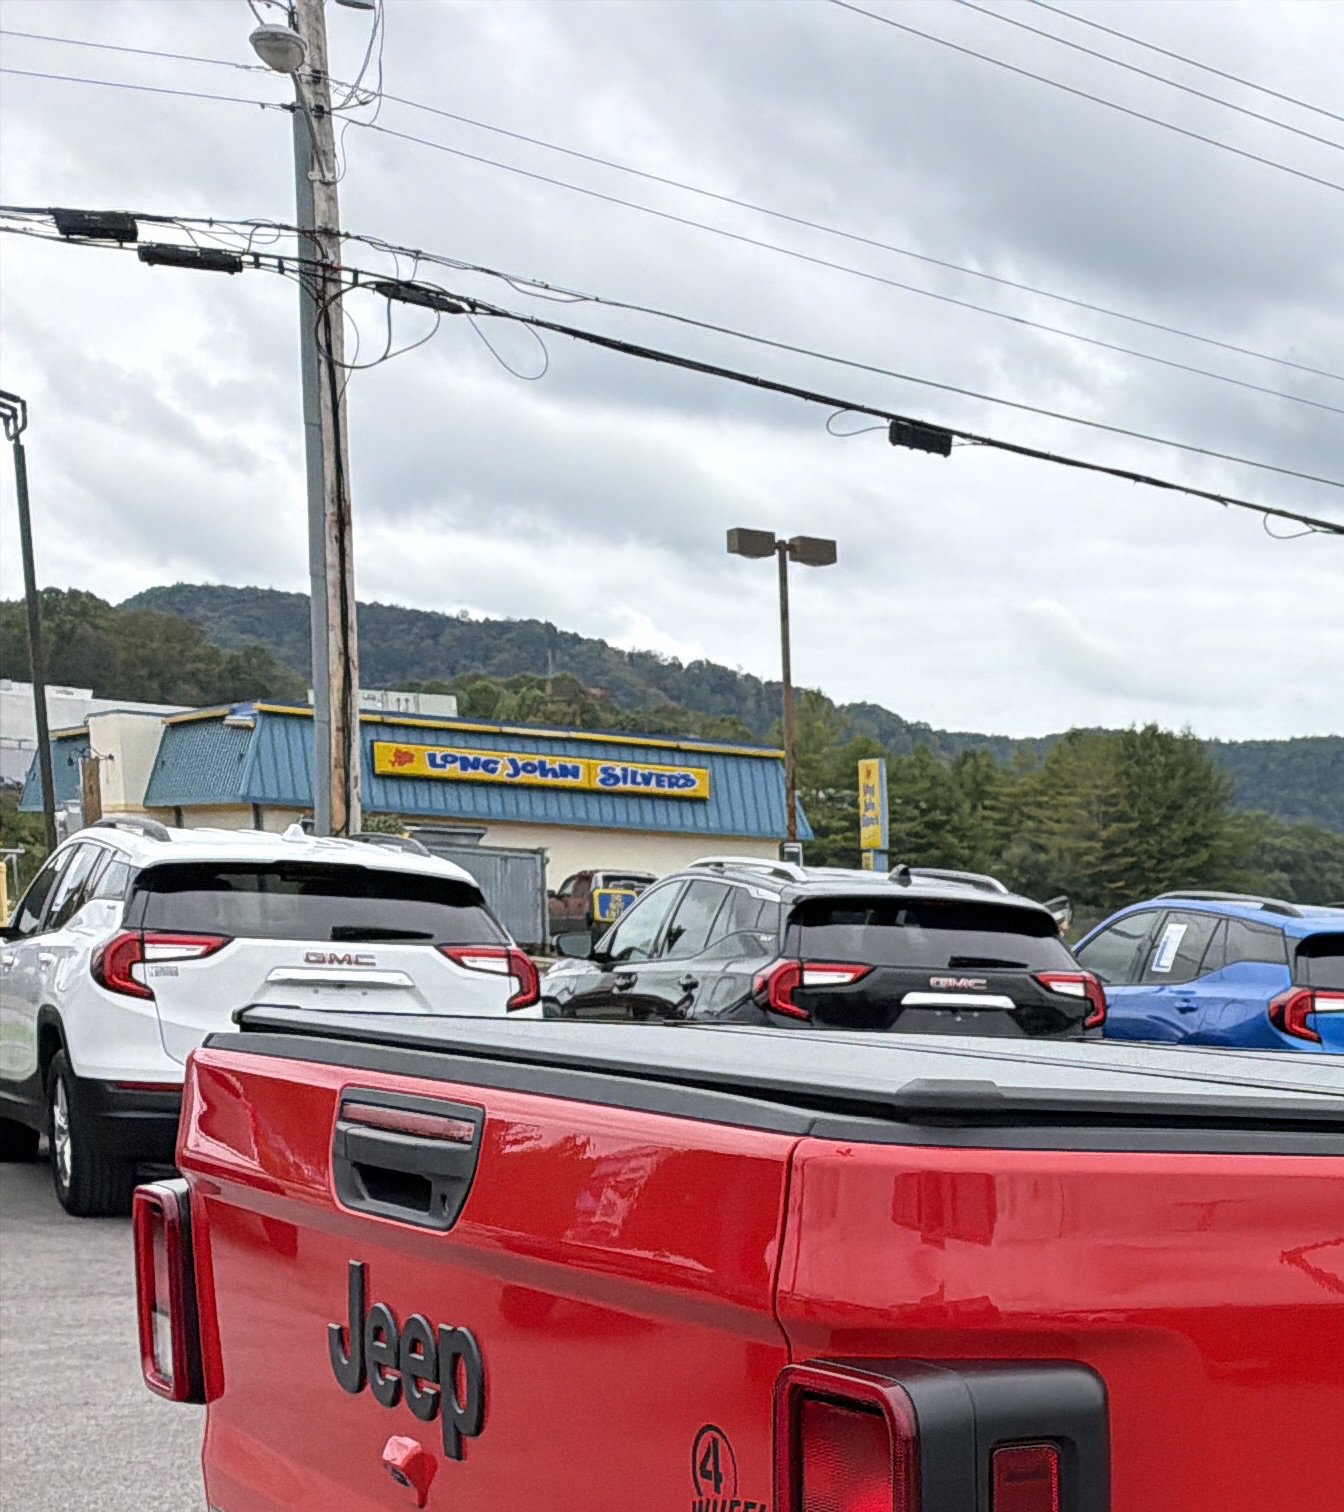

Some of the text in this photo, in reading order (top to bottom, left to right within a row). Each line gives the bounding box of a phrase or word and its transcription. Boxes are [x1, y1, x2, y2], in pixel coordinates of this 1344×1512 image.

[304, 951, 376, 966] GMC
[929, 976, 987, 990] GMC
[328, 1259, 485, 1461] Jeep
[700, 1436, 723, 1495] 4
